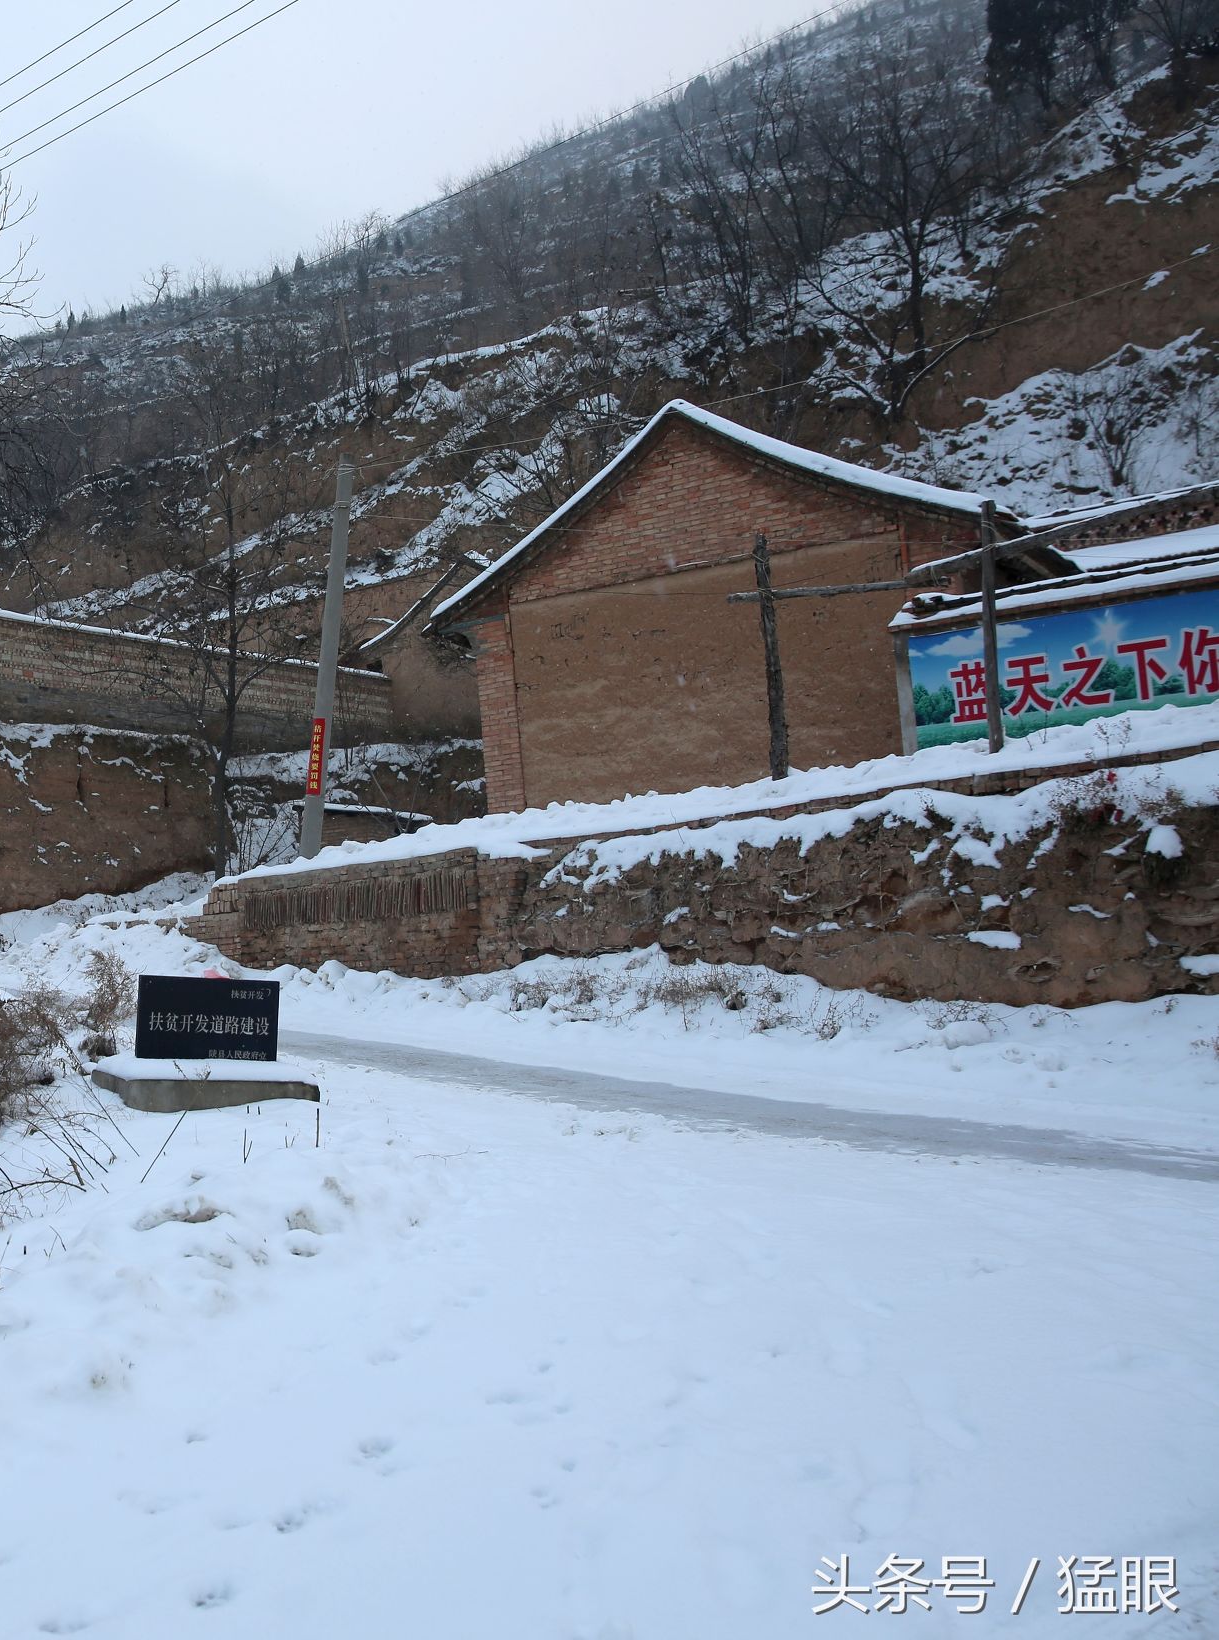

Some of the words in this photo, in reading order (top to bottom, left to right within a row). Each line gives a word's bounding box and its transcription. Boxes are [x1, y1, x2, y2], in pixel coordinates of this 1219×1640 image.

[309, 724, 322, 789] 秸秆焚烧要罚钱
[231, 989, 264, 1000] 扶贫开发
[149, 1012, 270, 1036] 扶贫开发道路建设
